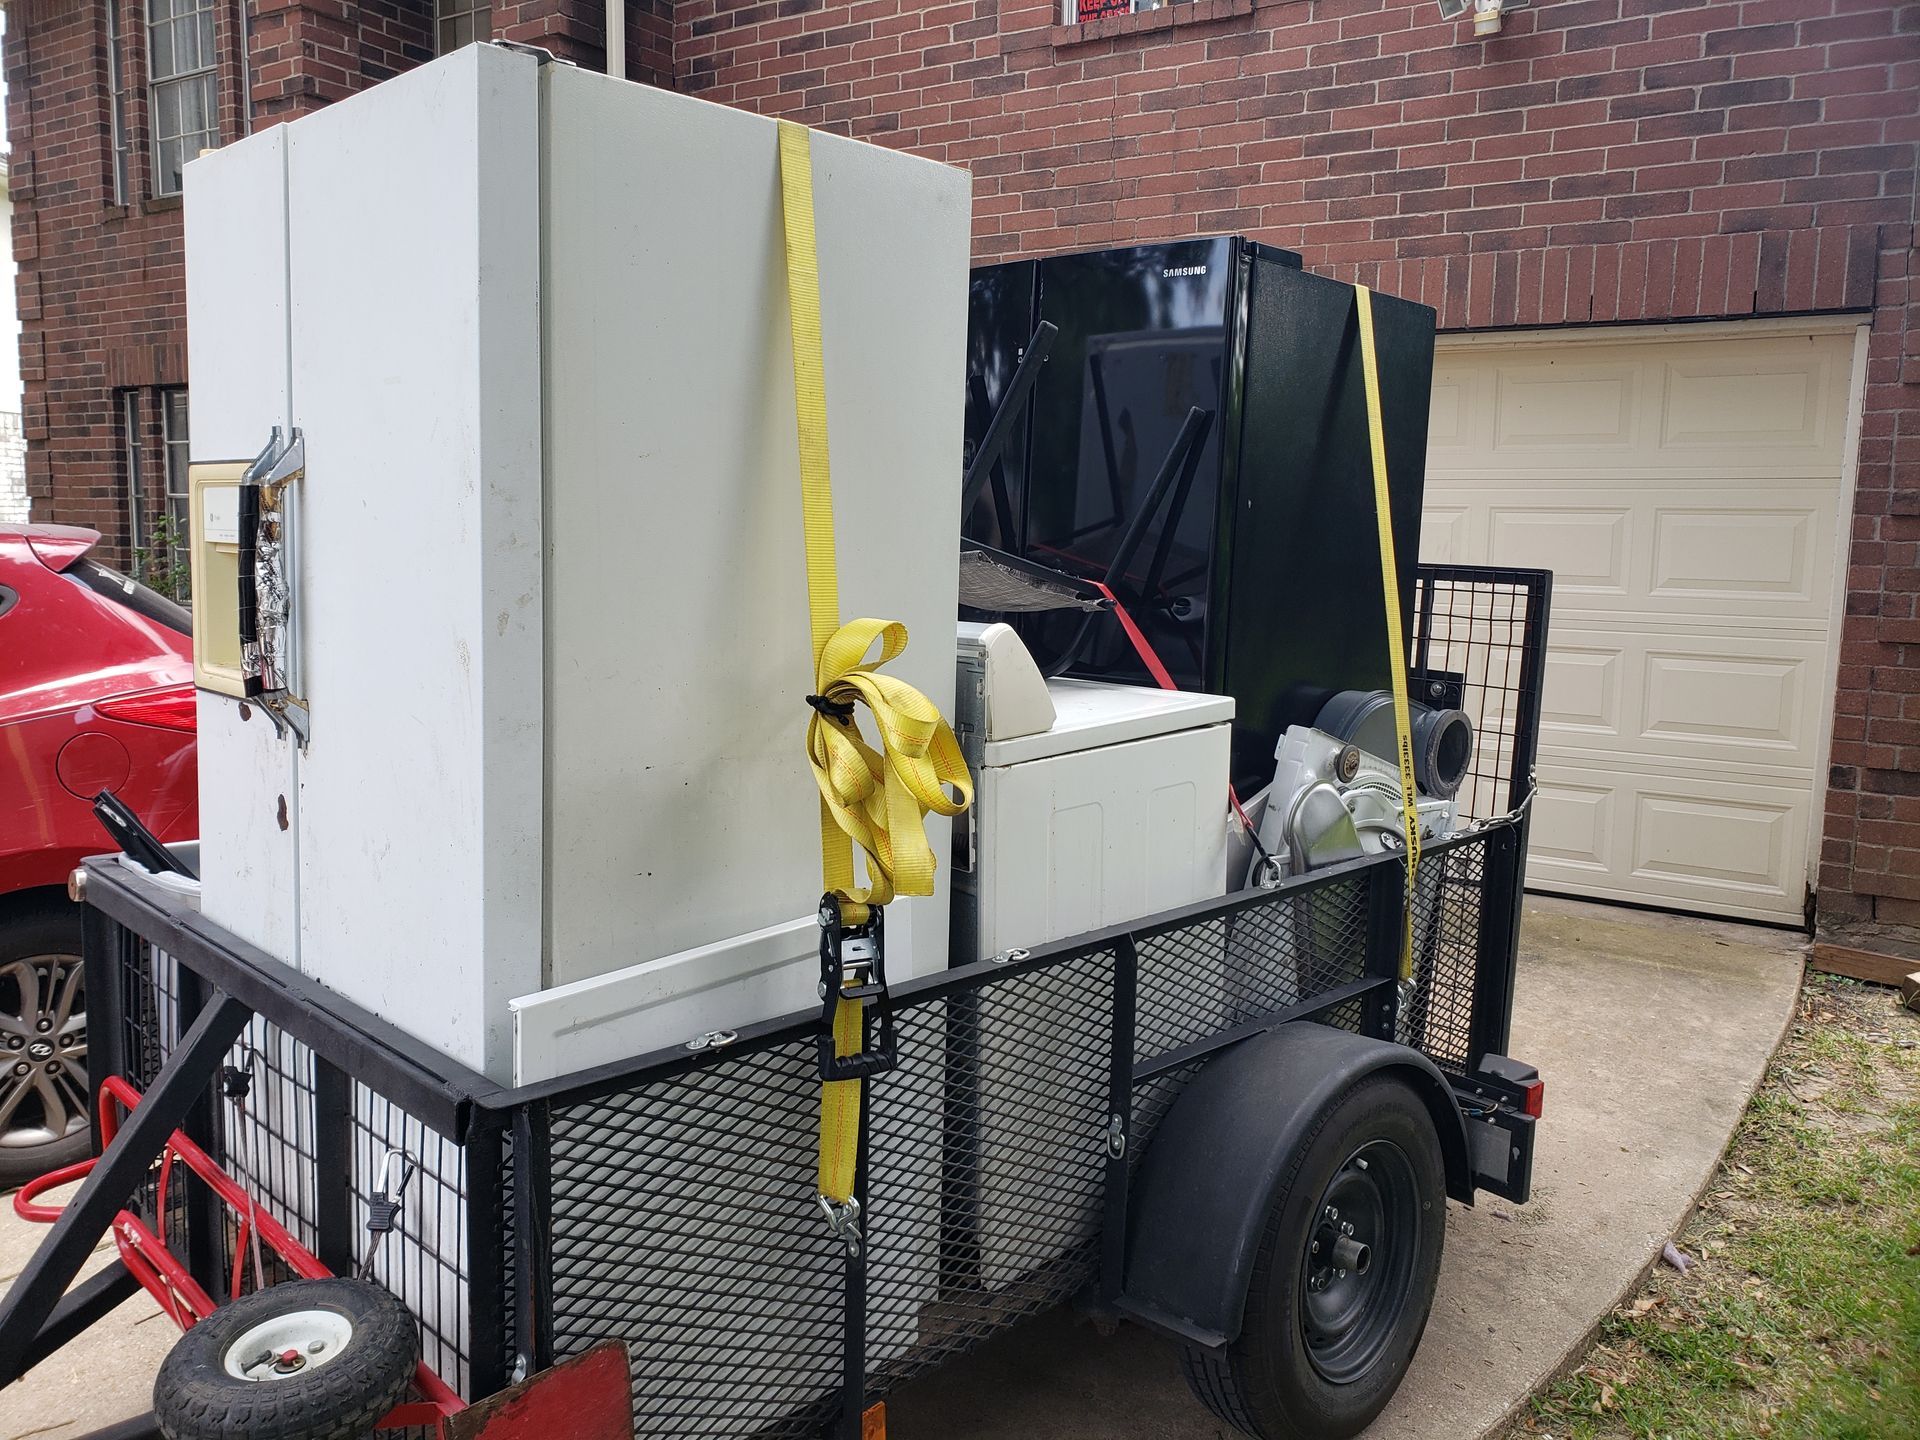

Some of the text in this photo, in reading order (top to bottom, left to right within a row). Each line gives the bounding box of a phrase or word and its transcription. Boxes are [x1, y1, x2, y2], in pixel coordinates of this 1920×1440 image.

[1163, 266, 1206, 277] SAMSUNG
[1402, 734, 1411, 780] 3333lbs
[1409, 815, 1418, 868] HUSKY
